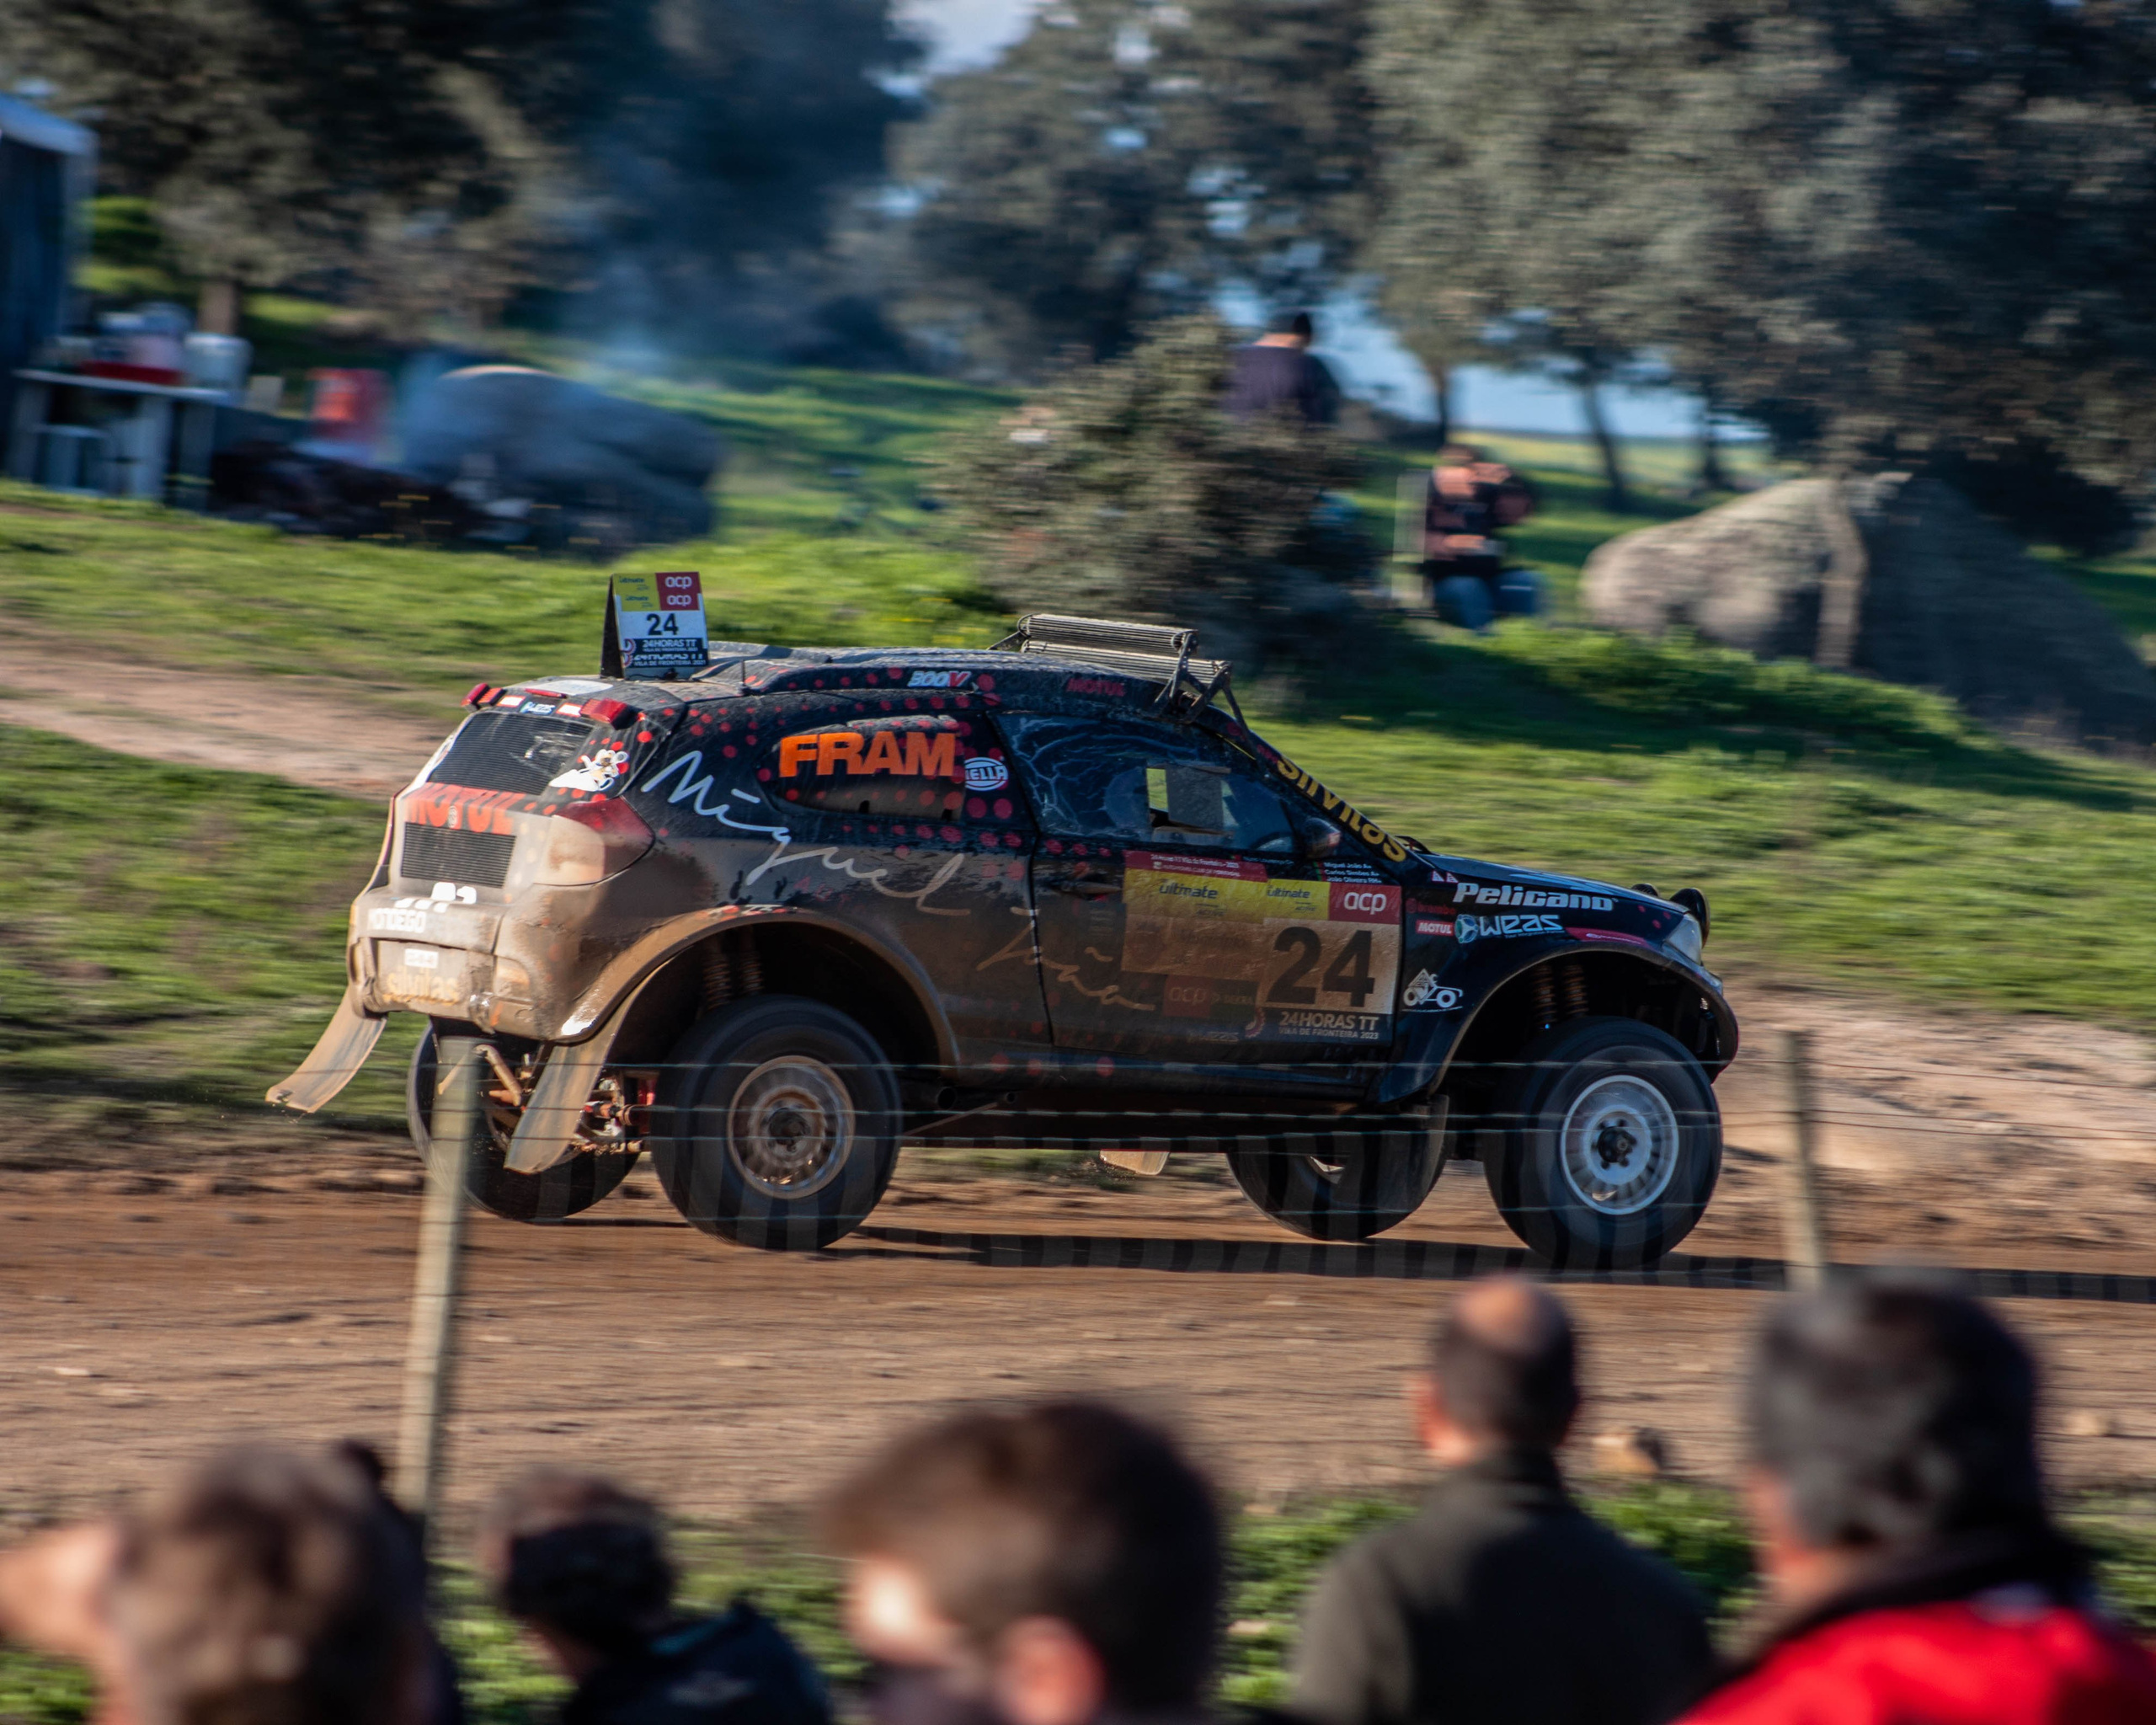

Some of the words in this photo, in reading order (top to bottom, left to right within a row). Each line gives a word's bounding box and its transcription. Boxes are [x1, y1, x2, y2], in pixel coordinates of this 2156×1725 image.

[664, 576, 692, 589] acp
[666, 595, 691, 606] acp
[646, 613, 679, 636] 24
[685, 638, 697, 647] TT
[907, 670, 972, 687] 300V
[779, 731, 956, 777] FRAM
[405, 782, 526, 835] MOTUL
[1159, 882, 1218, 899] ultimate
[1267, 887, 1310, 899] ultimate
[1453, 882, 1614, 911] Pelicano
[1343, 891, 1387, 915] acp
[1418, 921, 1452, 934] MOTUL
[1266, 927, 1375, 1007] 24
[1170, 986, 1207, 1006] acp
[1358, 1016, 1380, 1031] TT
[1278, 1027, 1298, 1035] VILA
[1299, 1028, 1311, 1036] DE
[1312, 1028, 1358, 1039] FRONTEIRA
